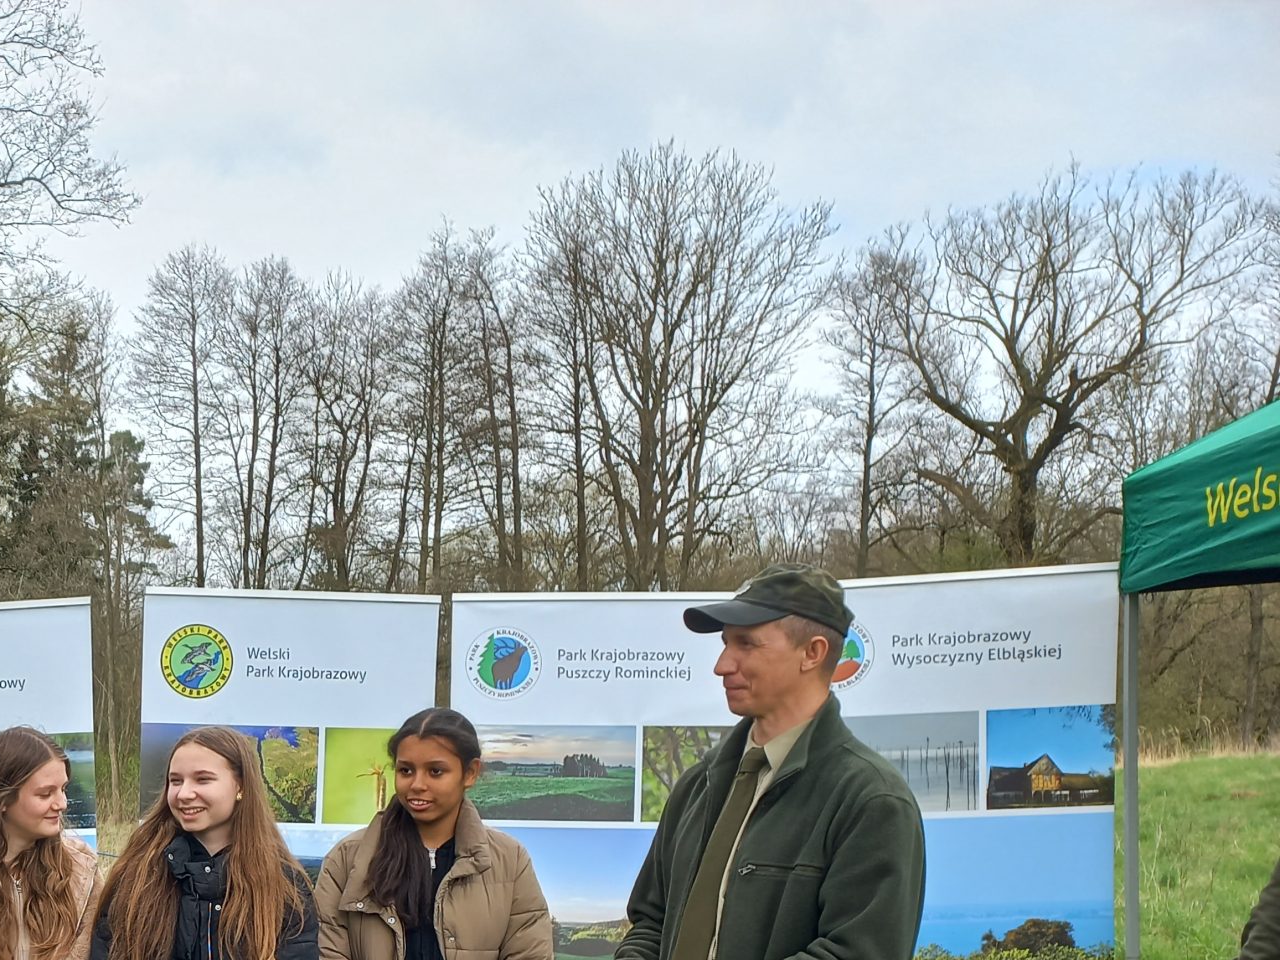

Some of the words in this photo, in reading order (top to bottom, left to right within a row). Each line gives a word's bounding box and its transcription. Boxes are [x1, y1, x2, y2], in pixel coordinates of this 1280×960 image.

[1206, 466, 1280, 527] Wels
[167, 627, 200, 648] WELSKI
[207, 629, 228, 650] PARK
[892, 634, 923, 647] Park
[927, 629, 1031, 647] Krajobrazowy
[247, 647, 290, 660] Welski
[557, 649, 587, 661] Park
[591, 649, 685, 664] Krajobrazowy
[892, 651, 983, 668] Wysoczyzny
[988, 644, 1062, 662] Elbląskiej
[164, 665, 230, 695] KRAJOBRAZOWY
[246, 665, 274, 678] Park
[278, 666, 367, 684] Krajobrazowy
[557, 667, 610, 682] Puszczy
[615, 666, 691, 681] Rominckiej
